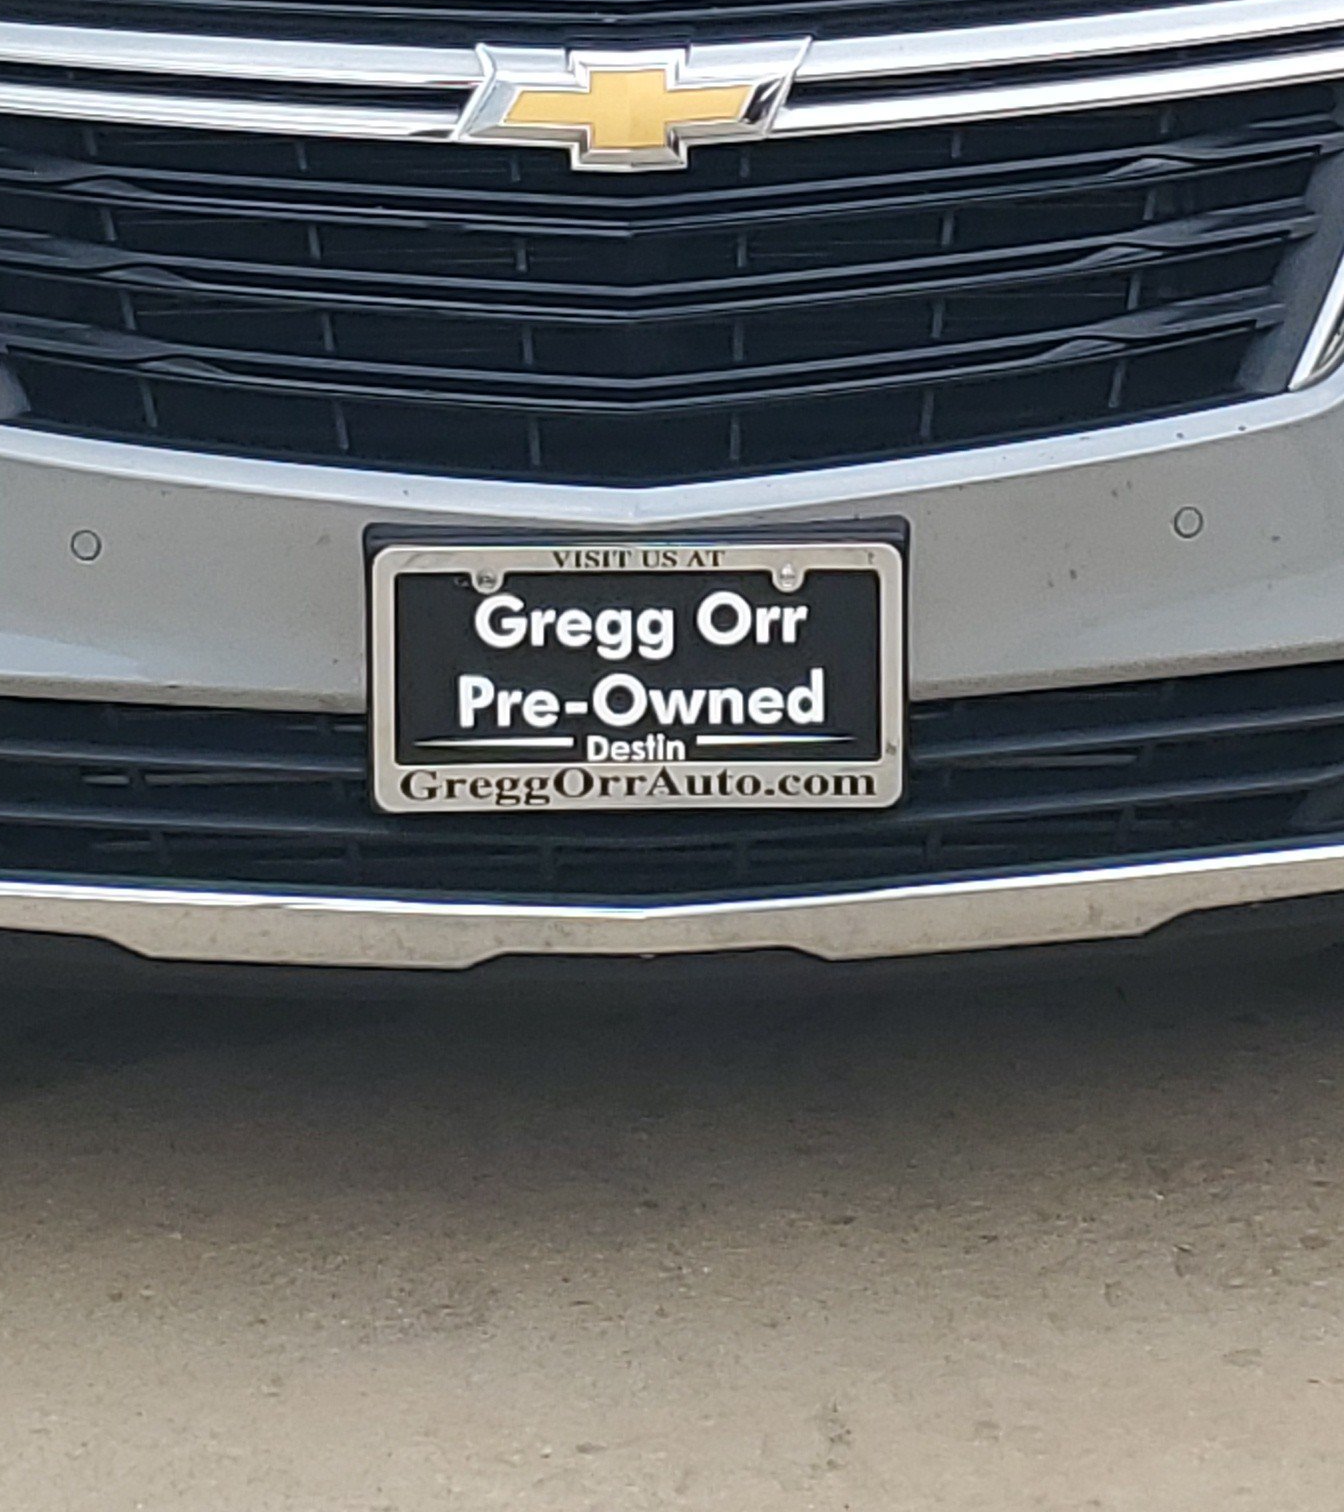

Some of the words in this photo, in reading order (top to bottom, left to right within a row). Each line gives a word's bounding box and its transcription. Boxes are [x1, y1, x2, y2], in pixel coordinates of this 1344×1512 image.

[552, 550, 633, 569] VISIT
[642, 550, 679, 568] US
[687, 549, 725, 567] AT
[474, 593, 674, 660] Gregg
[696, 590, 808, 645] Orr
[458, 667, 824, 728] Pre-Owned
[586, 733, 687, 762] Destin
[399, 766, 878, 806] GreggOrrAuto.com
